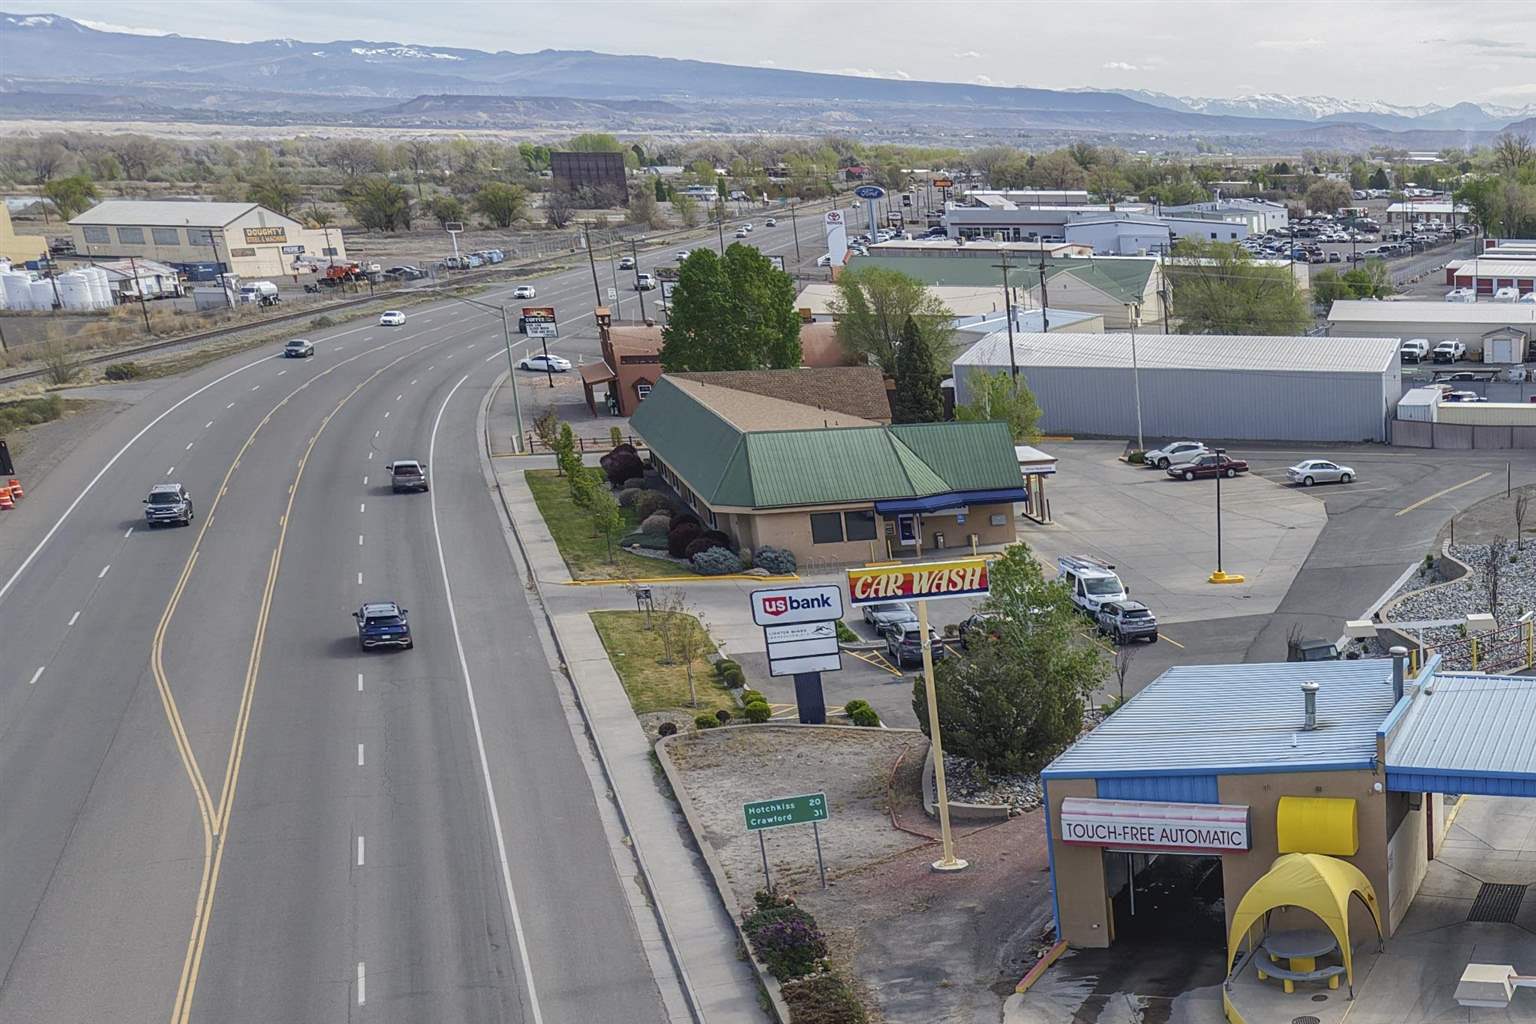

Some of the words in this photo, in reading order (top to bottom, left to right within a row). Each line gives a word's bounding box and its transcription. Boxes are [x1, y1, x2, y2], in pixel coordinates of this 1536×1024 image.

[246, 228, 282, 236] DOUGHTY
[855, 573, 904, 599] CAR
[912, 567, 982, 594] WASH
[765, 600, 786, 612] us
[789, 594, 831, 611] bank
[748, 803, 795, 814] Hotchkiss
[809, 798, 821, 807] 20
[751, 813, 792, 826] Crawford
[814, 809, 823, 817] 31
[1067, 823, 1155, 842] TOUCH-FREE
[1159, 828, 1242, 846] AUTOMATIC
